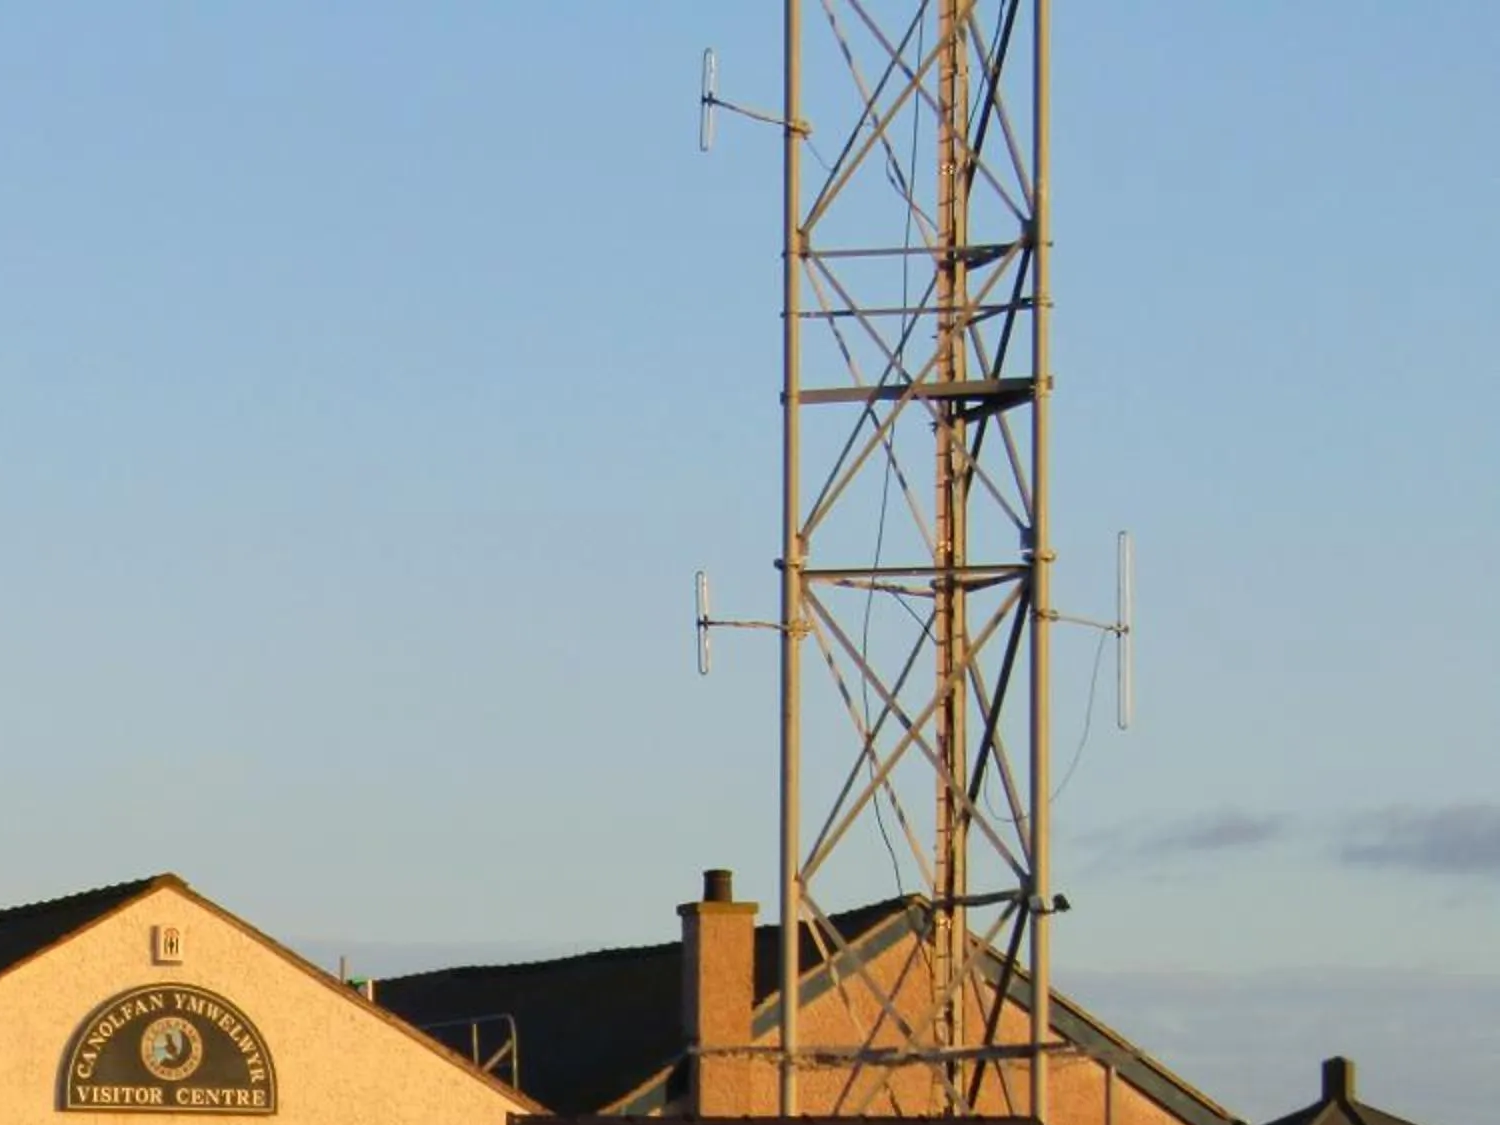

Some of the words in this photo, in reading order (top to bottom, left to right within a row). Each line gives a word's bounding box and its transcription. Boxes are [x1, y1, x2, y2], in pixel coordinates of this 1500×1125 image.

[77, 994, 164, 1079] CANOLFAN
[174, 993, 266, 1083] YMWELWYR
[76, 1086, 164, 1104] VISITOR
[176, 1087, 266, 1106] CENTRE
